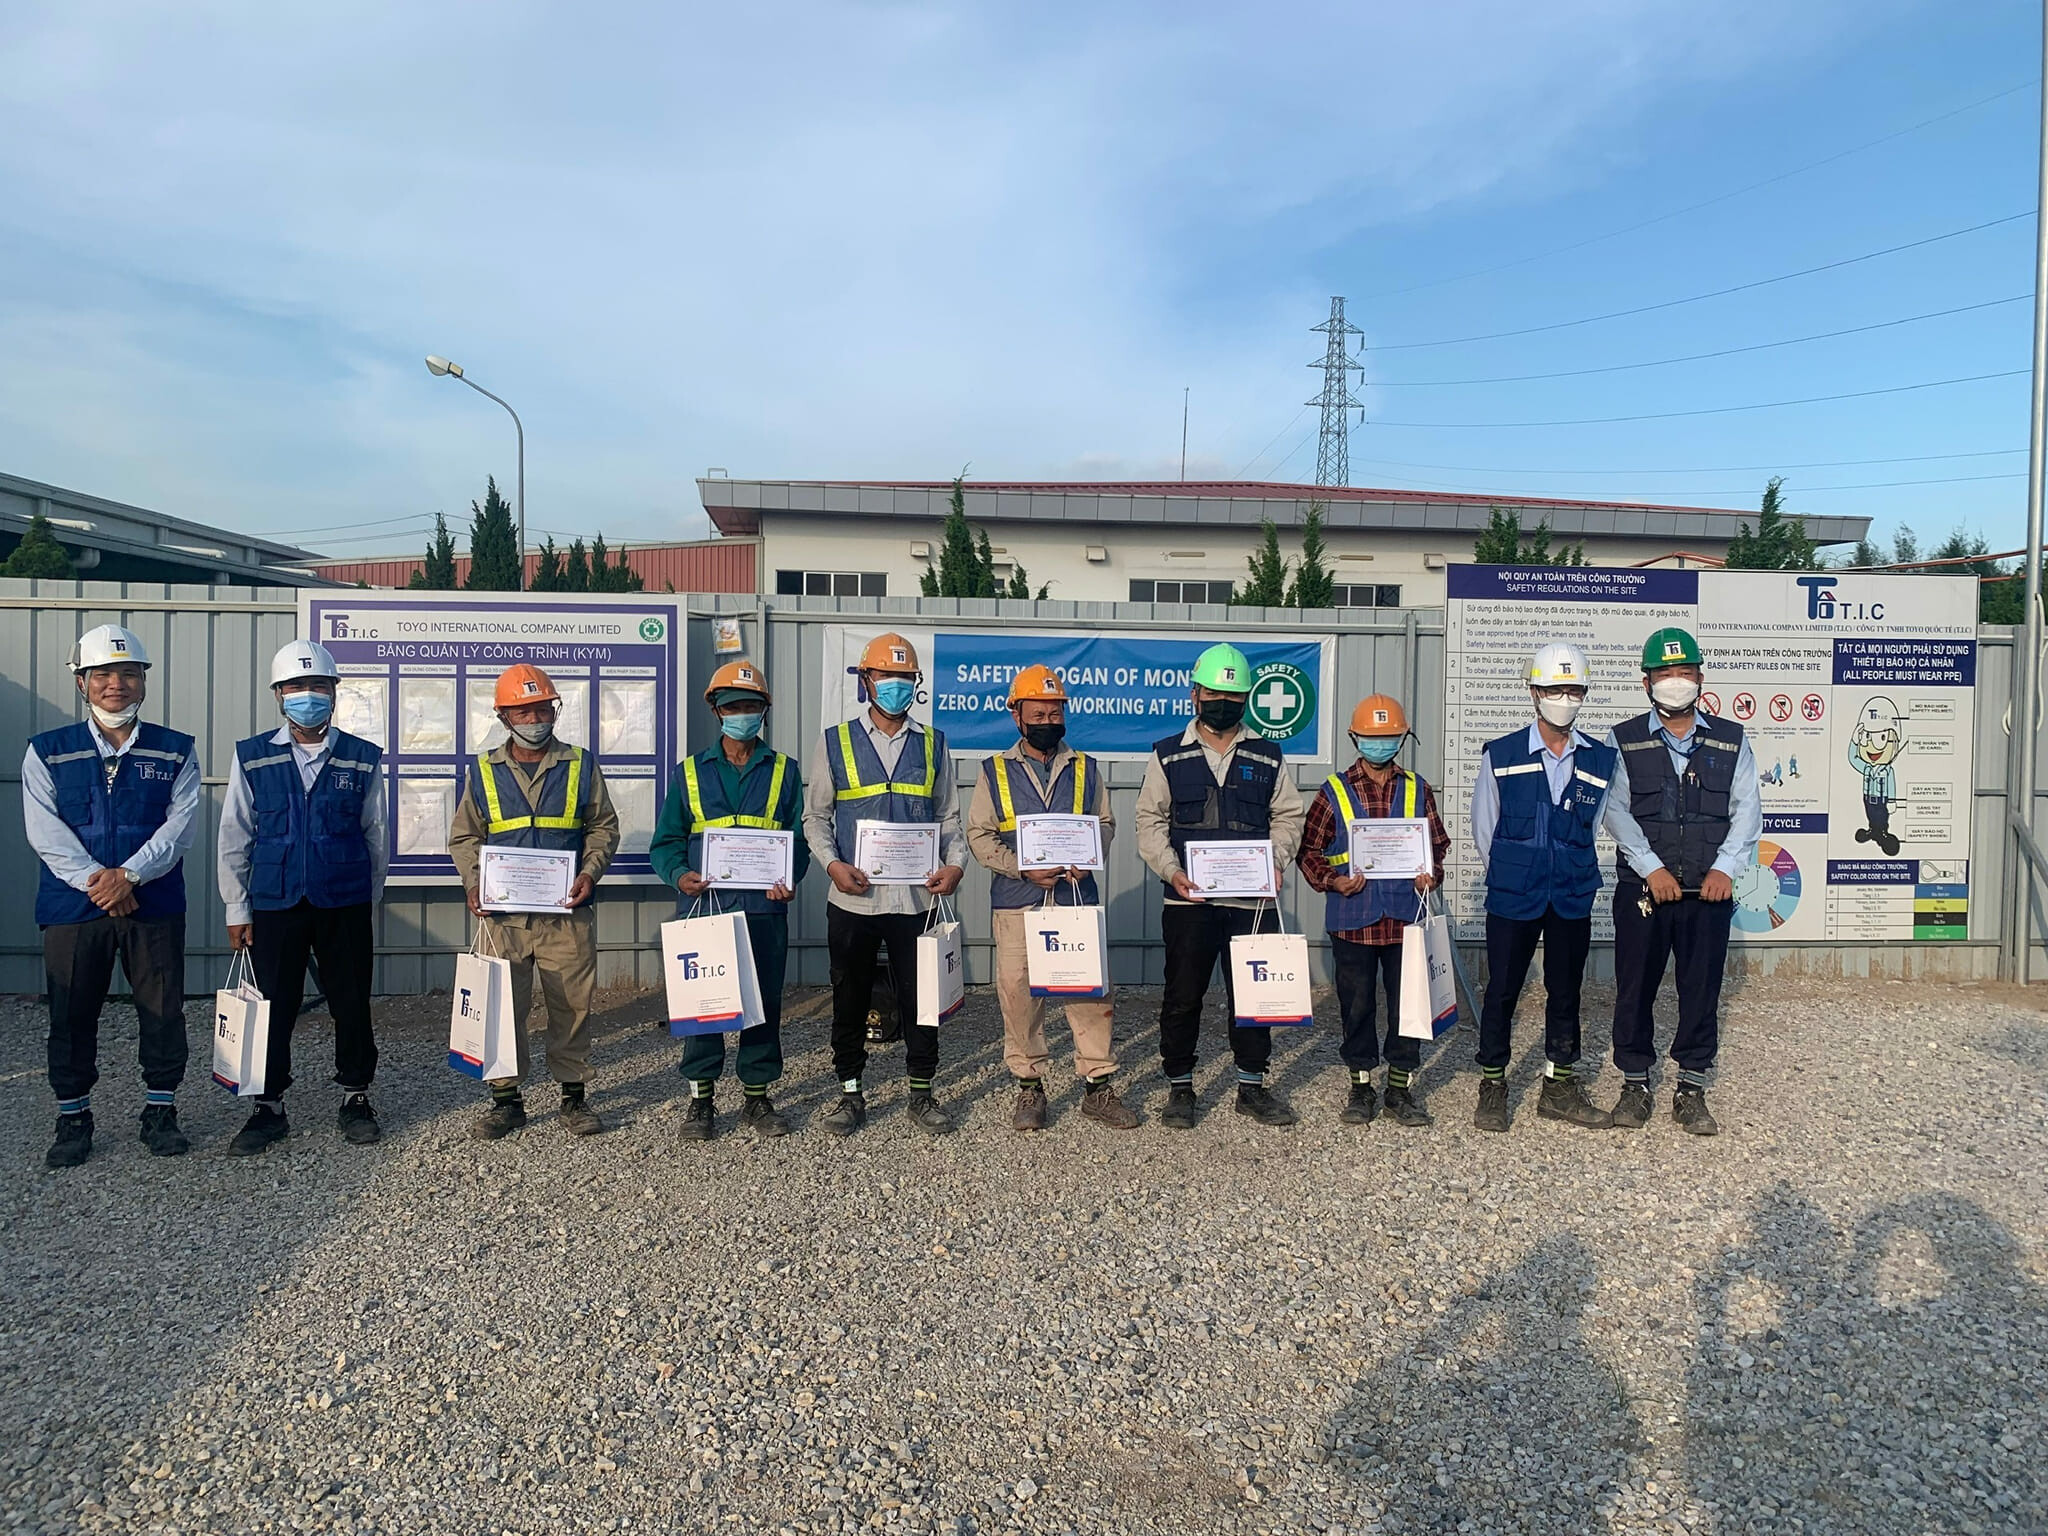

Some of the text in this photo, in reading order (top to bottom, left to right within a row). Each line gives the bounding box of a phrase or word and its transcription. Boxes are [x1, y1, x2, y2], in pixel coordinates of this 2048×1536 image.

[1498, 572, 1646, 584] NỘI QUY AN TOÀN TRÊN CÔNG TRƯỜNG
[1506, 584, 1638, 595] SAFETY REGULATIONS ON THE SITE
[1839, 603, 1885, 620] T.I.C
[397, 622, 622, 635] TOYO INTERNATIONAL COMPANY LIMITED
[1452, 622, 1456, 630] 1
[1700, 622, 1717, 630] TOYO
[1718, 623, 1771, 632] INTERNATIONAL
[1772, 624, 1804, 633] COMPANY
[1805, 624, 1833, 633] LIMITED
[1856, 624, 1875, 632] CÔNG
[351, 629, 378, 638] T.I.C
[1486, 630, 1514, 639] approved
[1516, 630, 1528, 639] type
[1529, 629, 1536, 637] of
[1551, 630, 1567, 638] when
[1466, 640, 1533, 649] Safety helmet with chin
[1592, 644, 1609, 653] safety
[1868, 644, 1883, 656] MỌI
[1884, 643, 1912, 654] NGƯỜI
[1946, 645, 1969, 656] DỤNG
[377, 643, 612, 662] BẢNG QUẢN LÝ CÔNG TRÌNH (KYM)
[1699, 648, 1713, 656] QUY
[1714, 648, 1730, 658] ĐỊNH
[1731, 649, 1740, 657] AN
[1742, 648, 1760, 658] TOÀN
[1762, 648, 1780, 658] TRÊN
[1782, 648, 1802, 658] CÔNG
[1450, 660, 1456, 668] 2
[1708, 661, 1821, 671] BASIC SAFETY RULES ON THE SITE
[1256, 663, 1301, 678] SAFETY
[1474, 667, 1487, 676] obey
[1498, 668, 1516, 677] safety
[1114, 668, 1138, 686] OF
[1842, 670, 1963, 683] (ALL PEOPLE MUST WEAR PPE)
[1450, 685, 1455, 693] 3
[938, 693, 979, 712] ZERO
[1068, 696, 1144, 715] WORKING
[1148, 698, 1167, 715] AT
[1450, 711, 1455, 720] 4
[1473, 722, 1499, 730] smoking
[1261, 727, 1293, 739] FIRST
[1449, 738, 1454, 748] 5
[1774, 818, 1801, 828] CYCLE
[1446, 871, 1454, 880] 10
[1062, 942, 1085, 952] T.I.C
[701, 964, 726, 978] T.I.C
[1270, 972, 1294, 982] T.I.C
